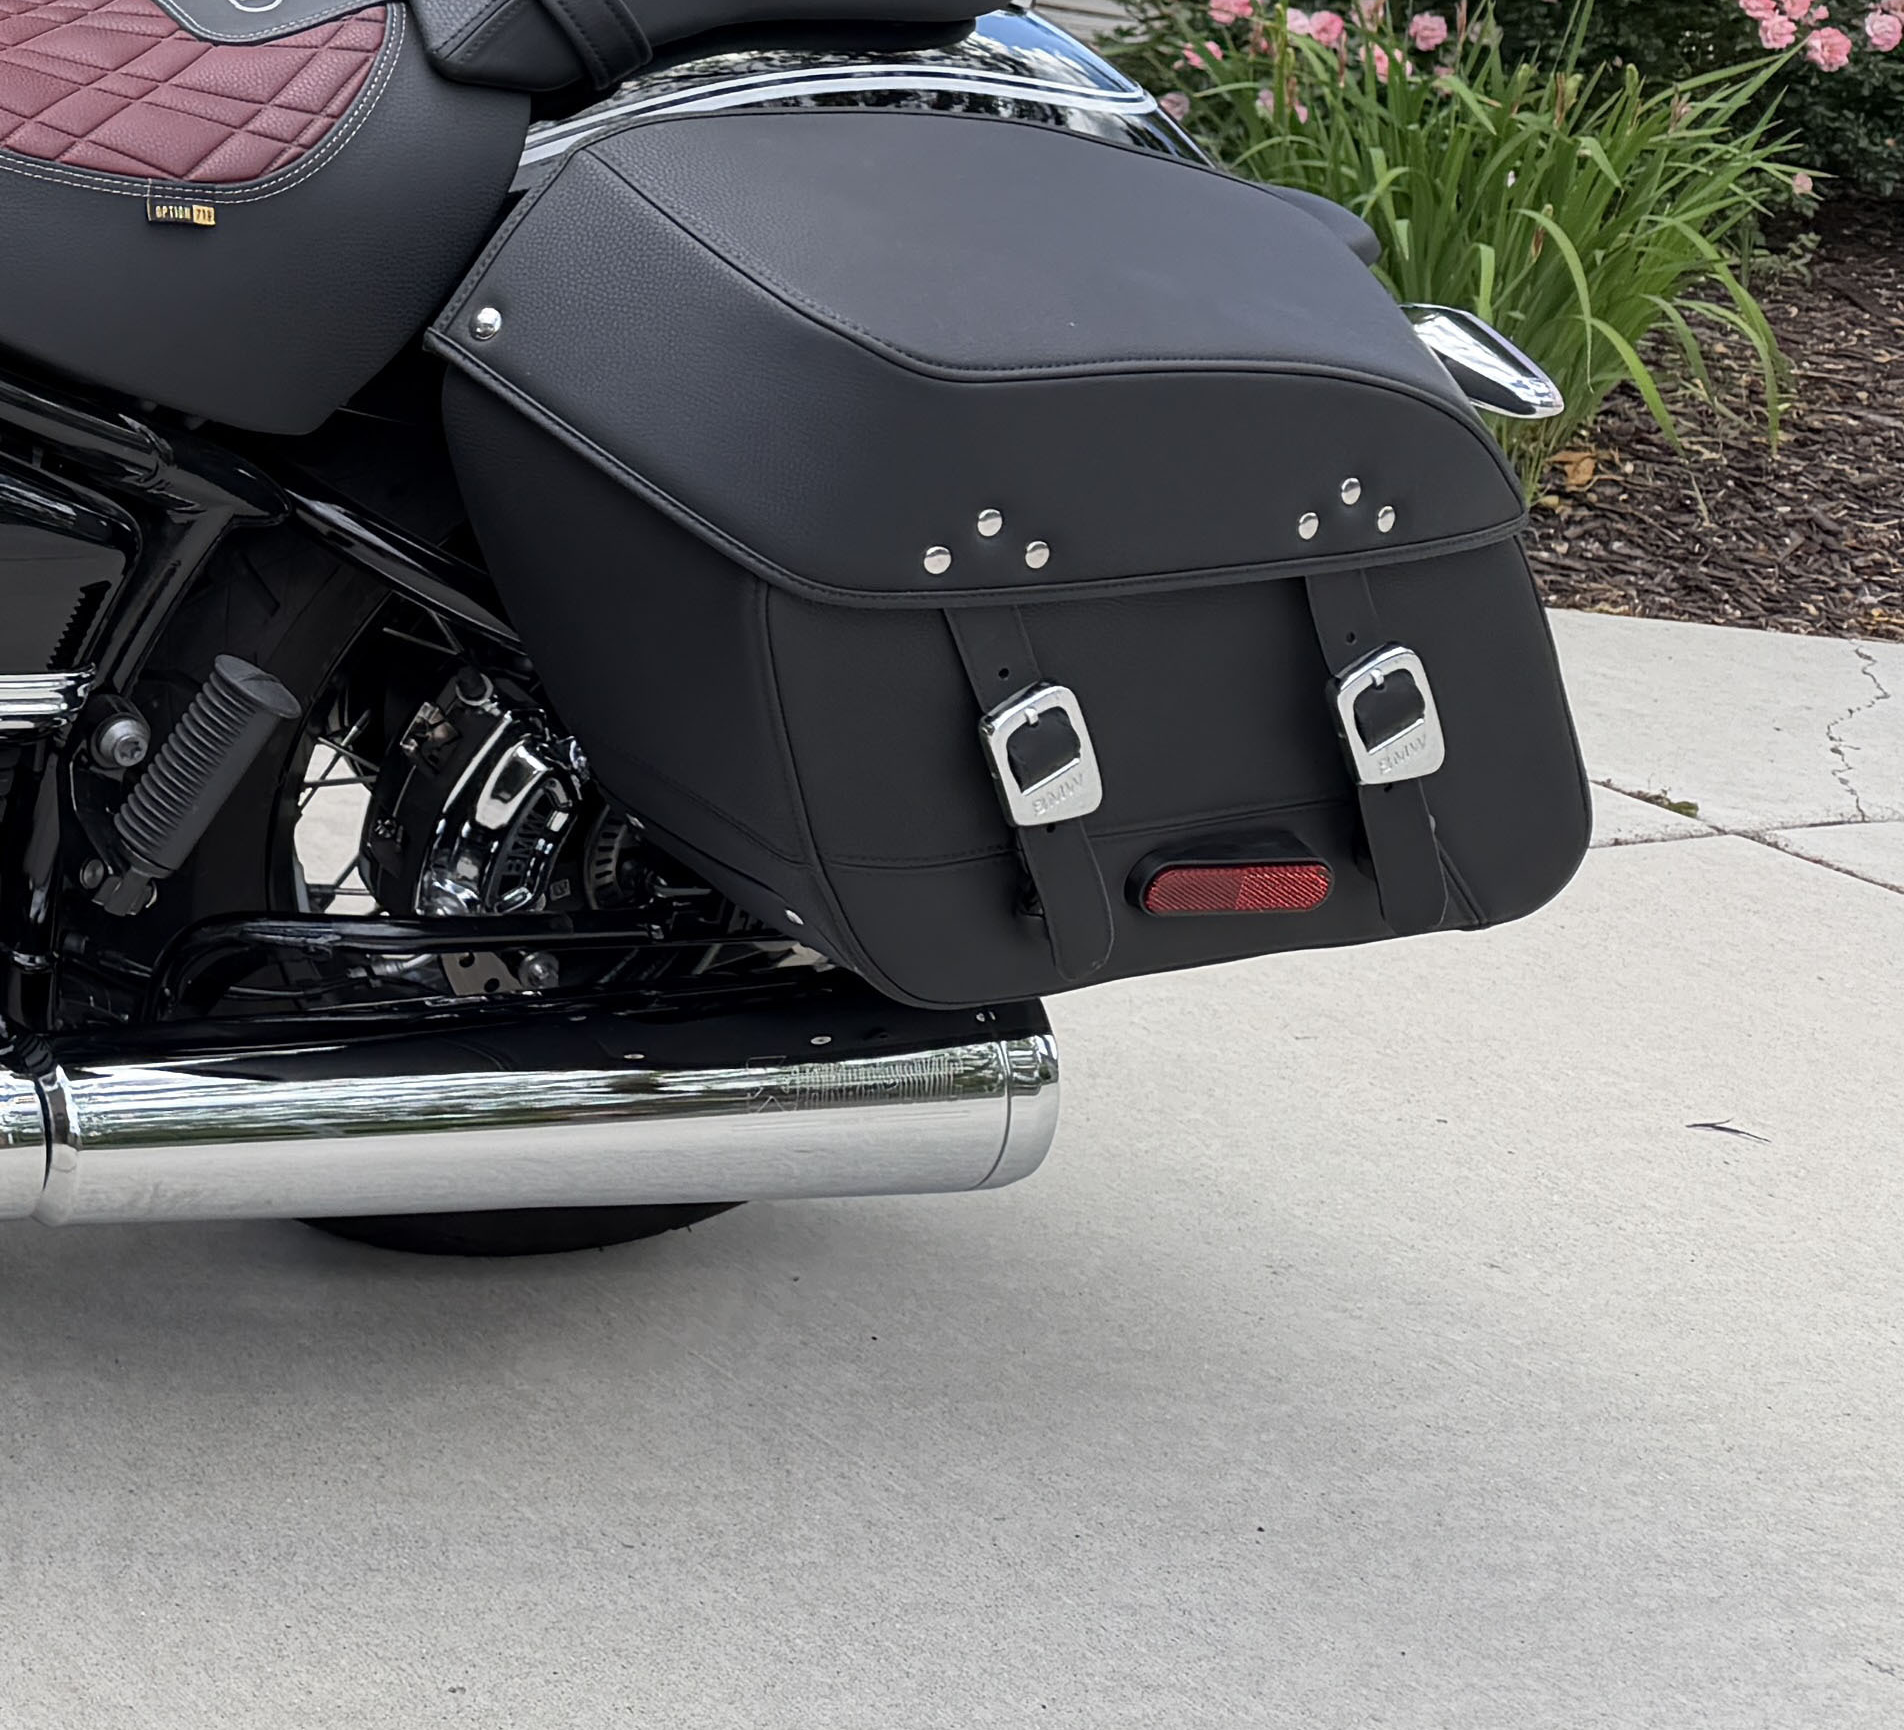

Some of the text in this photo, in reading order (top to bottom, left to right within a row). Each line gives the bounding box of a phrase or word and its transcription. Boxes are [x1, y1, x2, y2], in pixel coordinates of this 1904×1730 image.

[1378, 733, 1427, 776] BMW
[1032, 772, 1083, 818] BMW
[504, 810, 544, 876] BMW
